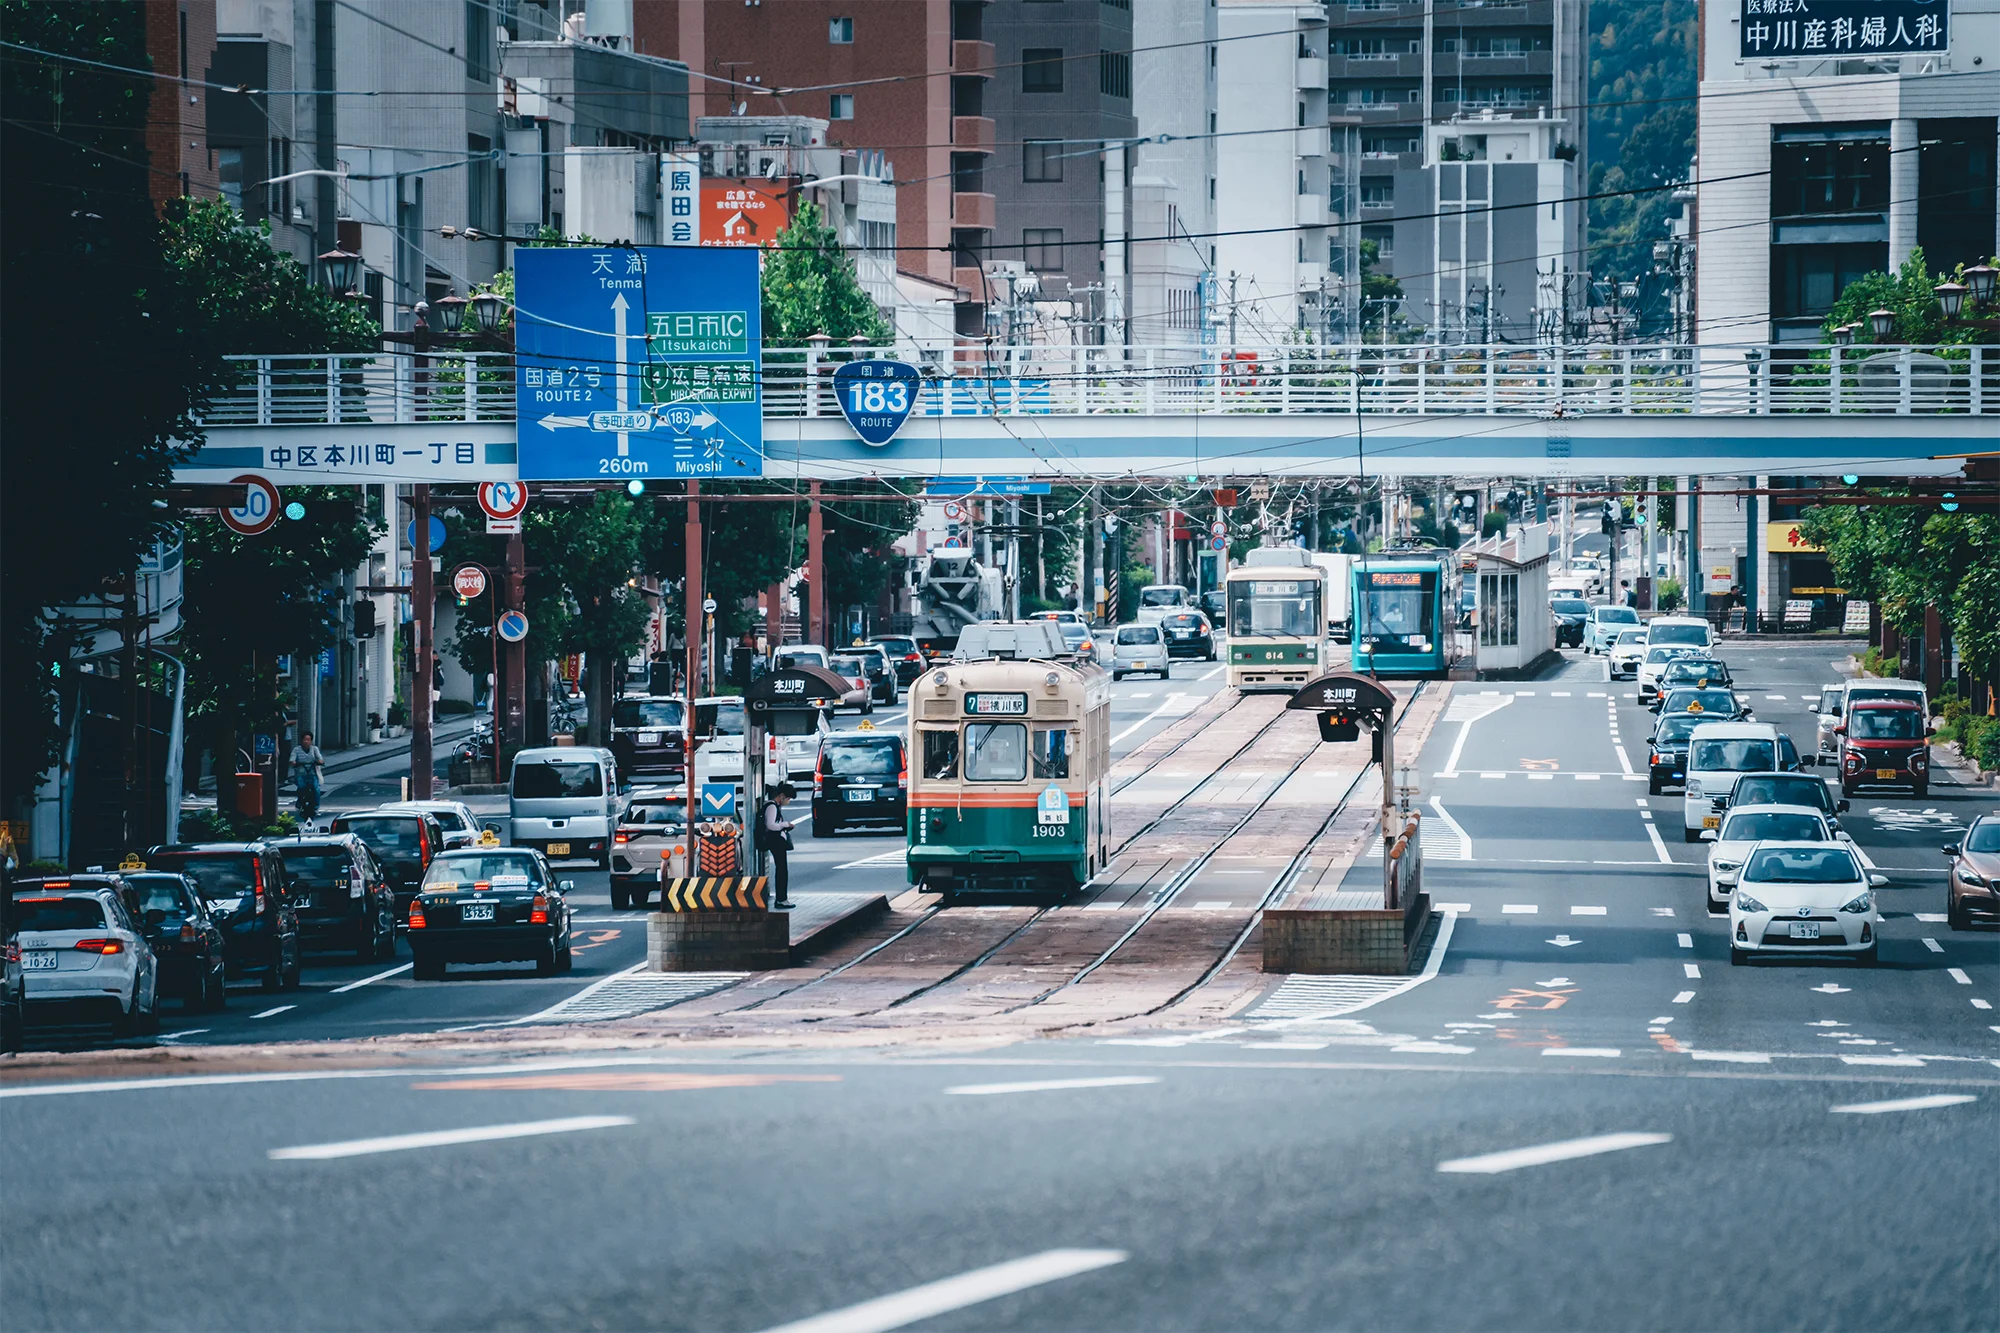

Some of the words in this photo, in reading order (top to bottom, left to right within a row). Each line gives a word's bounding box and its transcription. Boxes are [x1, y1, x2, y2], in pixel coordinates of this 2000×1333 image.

[1747, 0, 1809, 15] 医療法人
[1746, 14, 1943, 51] 中川産科婦人科
[726, 190, 756, 200] 広島で
[670, 171, 692, 242] 原田会
[591, 254, 648, 275] 天満
[599, 277, 643, 289] Tenma
[662, 340, 732, 351] Itsukaichi
[525, 366, 602, 389] 国道2号
[652, 370, 661, 384] 4
[672, 364, 752, 386] 広島高速
[861, 365, 894, 377] 国道
[536, 389, 575, 402] ROUTE
[584, 389, 592, 401] 2
[669, 388, 720, 401] HIROSHIMA
[722, 387, 753, 400] EXPWY
[849, 382, 908, 413] 183
[599, 413, 647, 428] 寺町通り
[670, 411, 691, 424] 183
[860, 417, 893, 428] ROUTE
[672, 436, 726, 459] 三次
[270, 443, 475, 468] 中区本川町一丁目
[599, 458, 649, 474] 260m
[675, 460, 723, 475] Miyoshi
[1005, 484, 1030, 492] Miyoshi
[947, 562, 959, 571] 12
[457, 575, 483, 589] 消火栓
[774, 679, 805, 690] 本川町
[1323, 688, 1357, 699] 本川町
[968, 696, 977, 711] 7
[990, 700, 1023, 711] 横川駅
[1032, 825, 1066, 838] 1903
